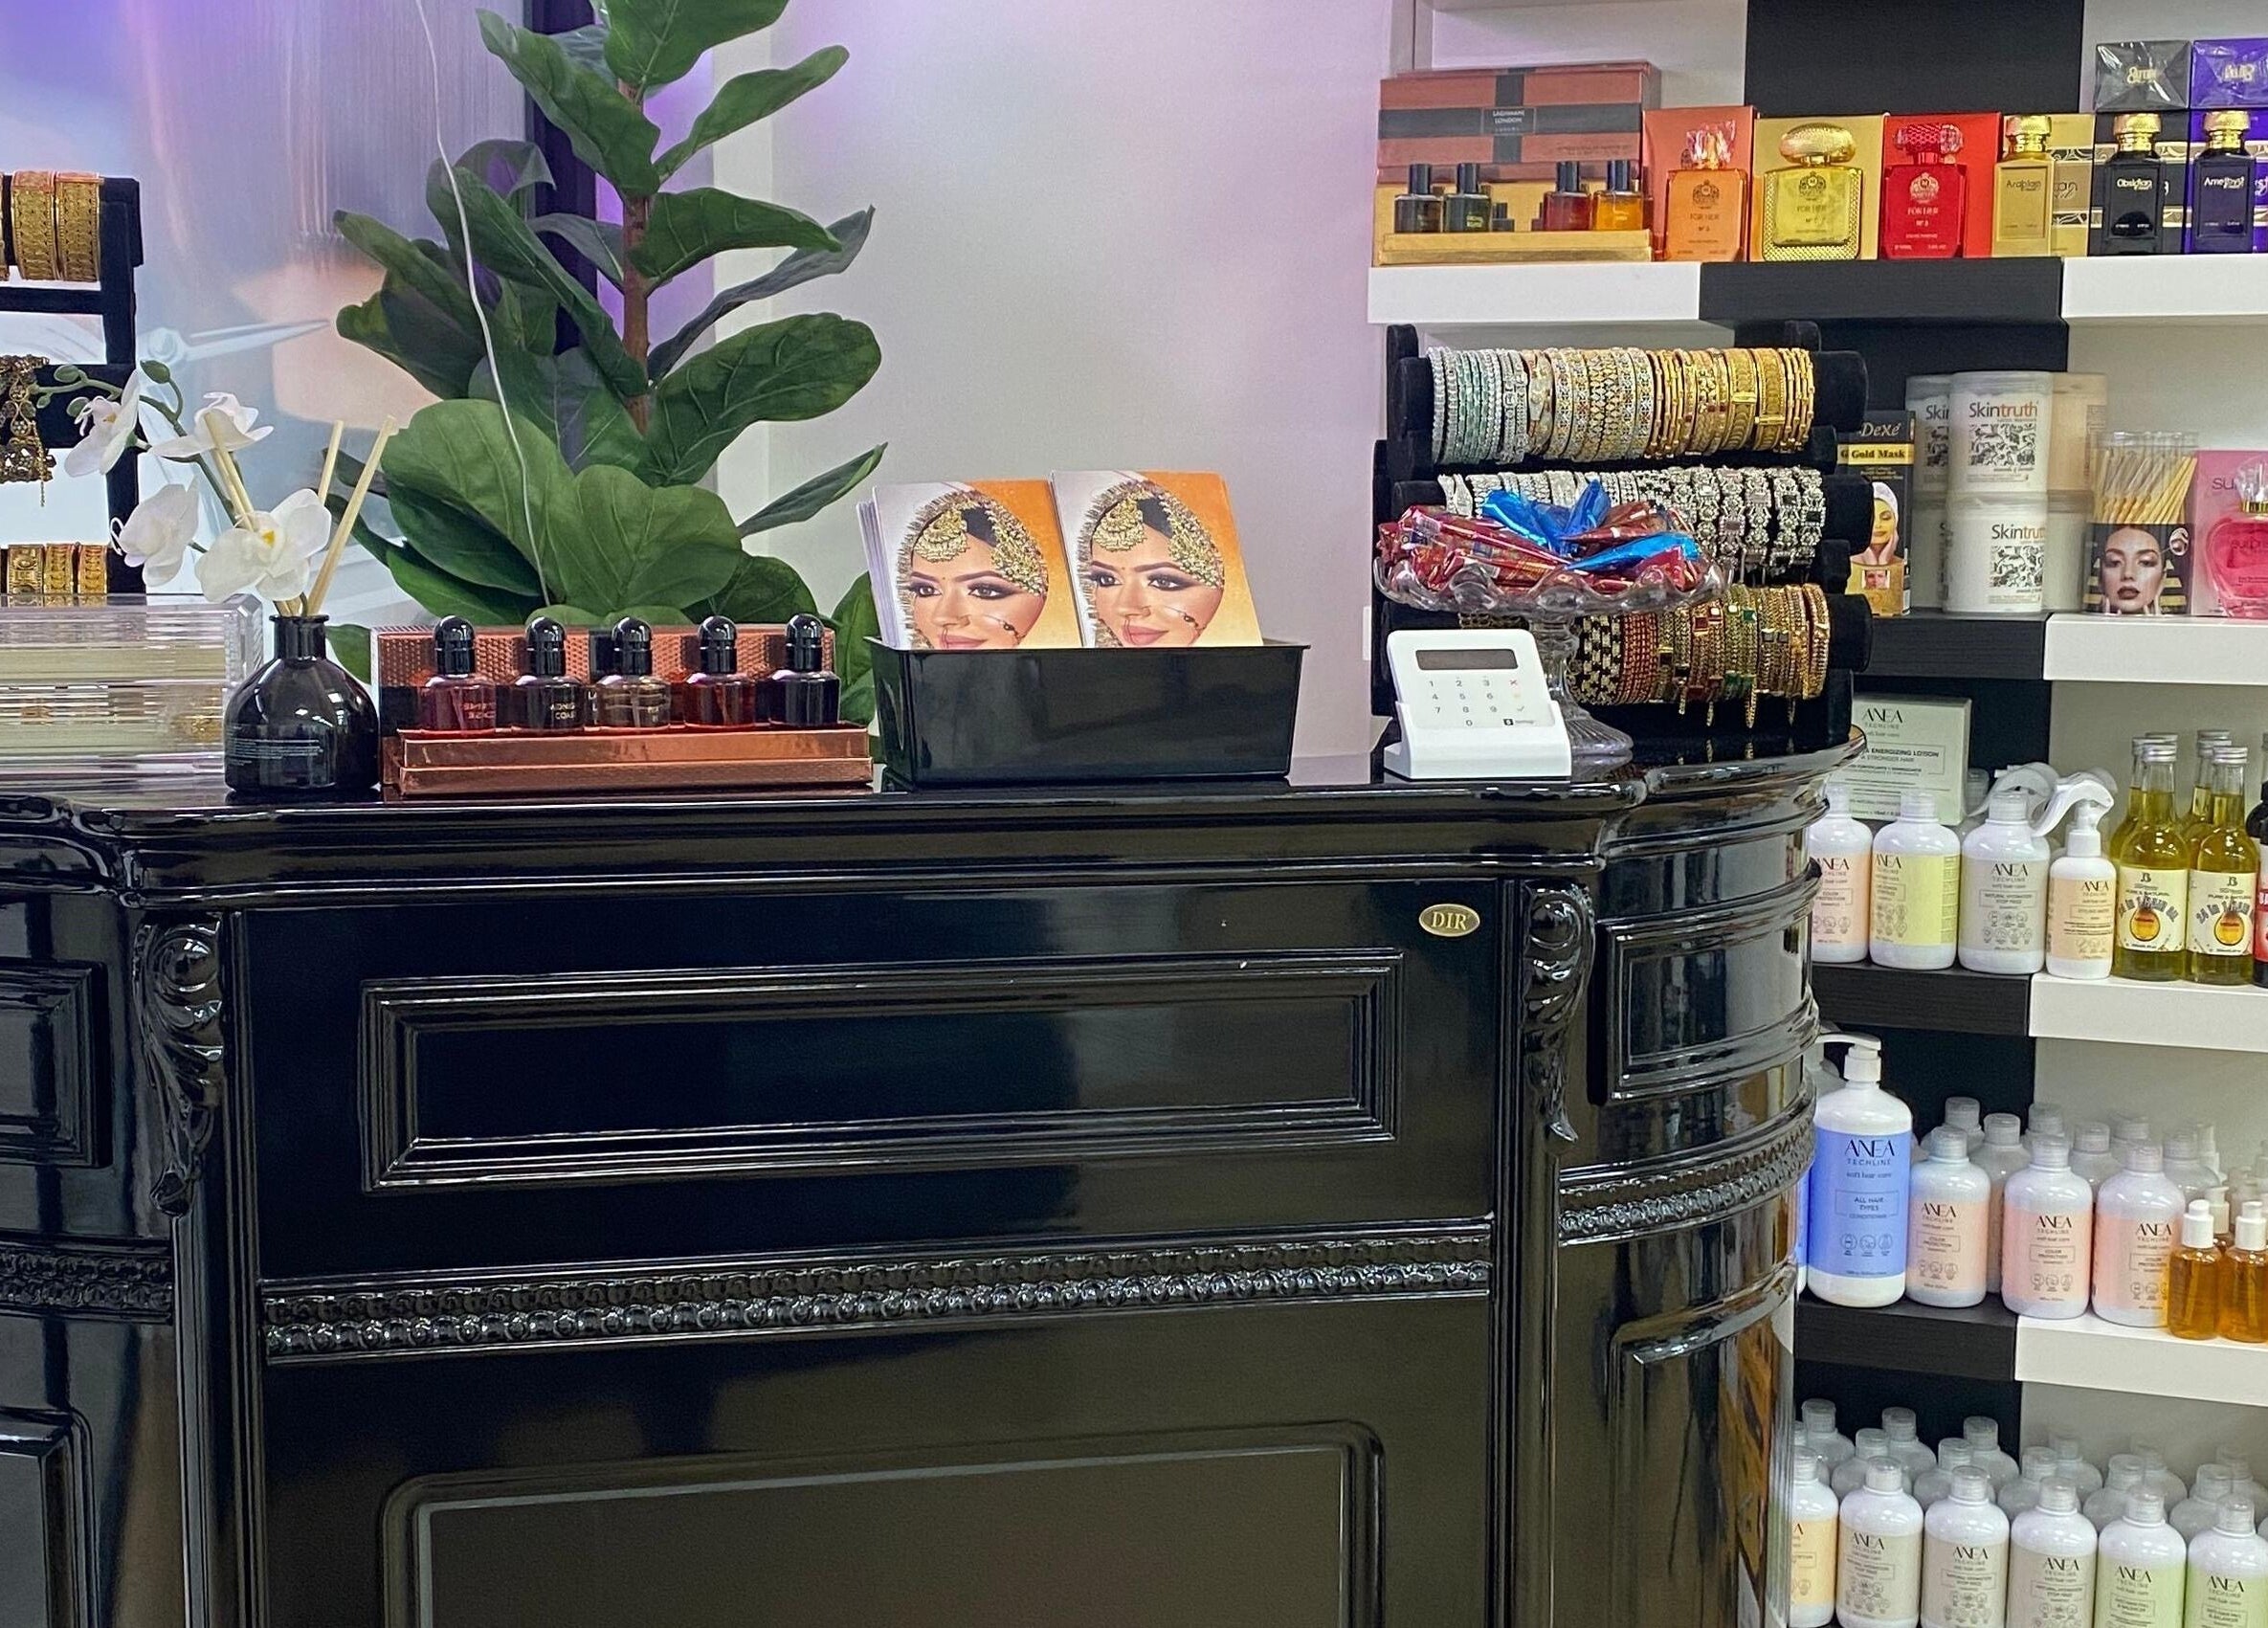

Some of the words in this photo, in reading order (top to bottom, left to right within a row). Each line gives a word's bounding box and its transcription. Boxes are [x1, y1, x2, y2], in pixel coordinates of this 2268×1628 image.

[1968, 401, 2038, 418] Skintruth
[1858, 421, 1902, 437] Dexé
[1851, 449, 1876, 459] Gold
[1877, 449, 1906, 459] Mask
[1862, 708, 1903, 724] ANEA
[1871, 747, 1912, 756] ENERGIZING
[1990, 862, 2029, 877] ANEA
[2080, 881, 2110, 892] ANEA
[1431, 911, 1467, 931] DIR
[1844, 1138, 1896, 1159] ANEA
[1847, 1157, 1892, 1166] TECHLINE
[1922, 1202, 1957, 1218] ANEA
[2035, 1215, 2073, 1229] ANEA
[2135, 1222, 2172, 1237] ANEA
[1853, 1531, 1885, 1550] ANEA
[1953, 1546, 1989, 1560] ANEA
[2043, 1556, 2080, 1571] ANEA
[2116, 1565, 2152, 1583] ANEA
[2207, 1574, 2245, 1593] ANEA
